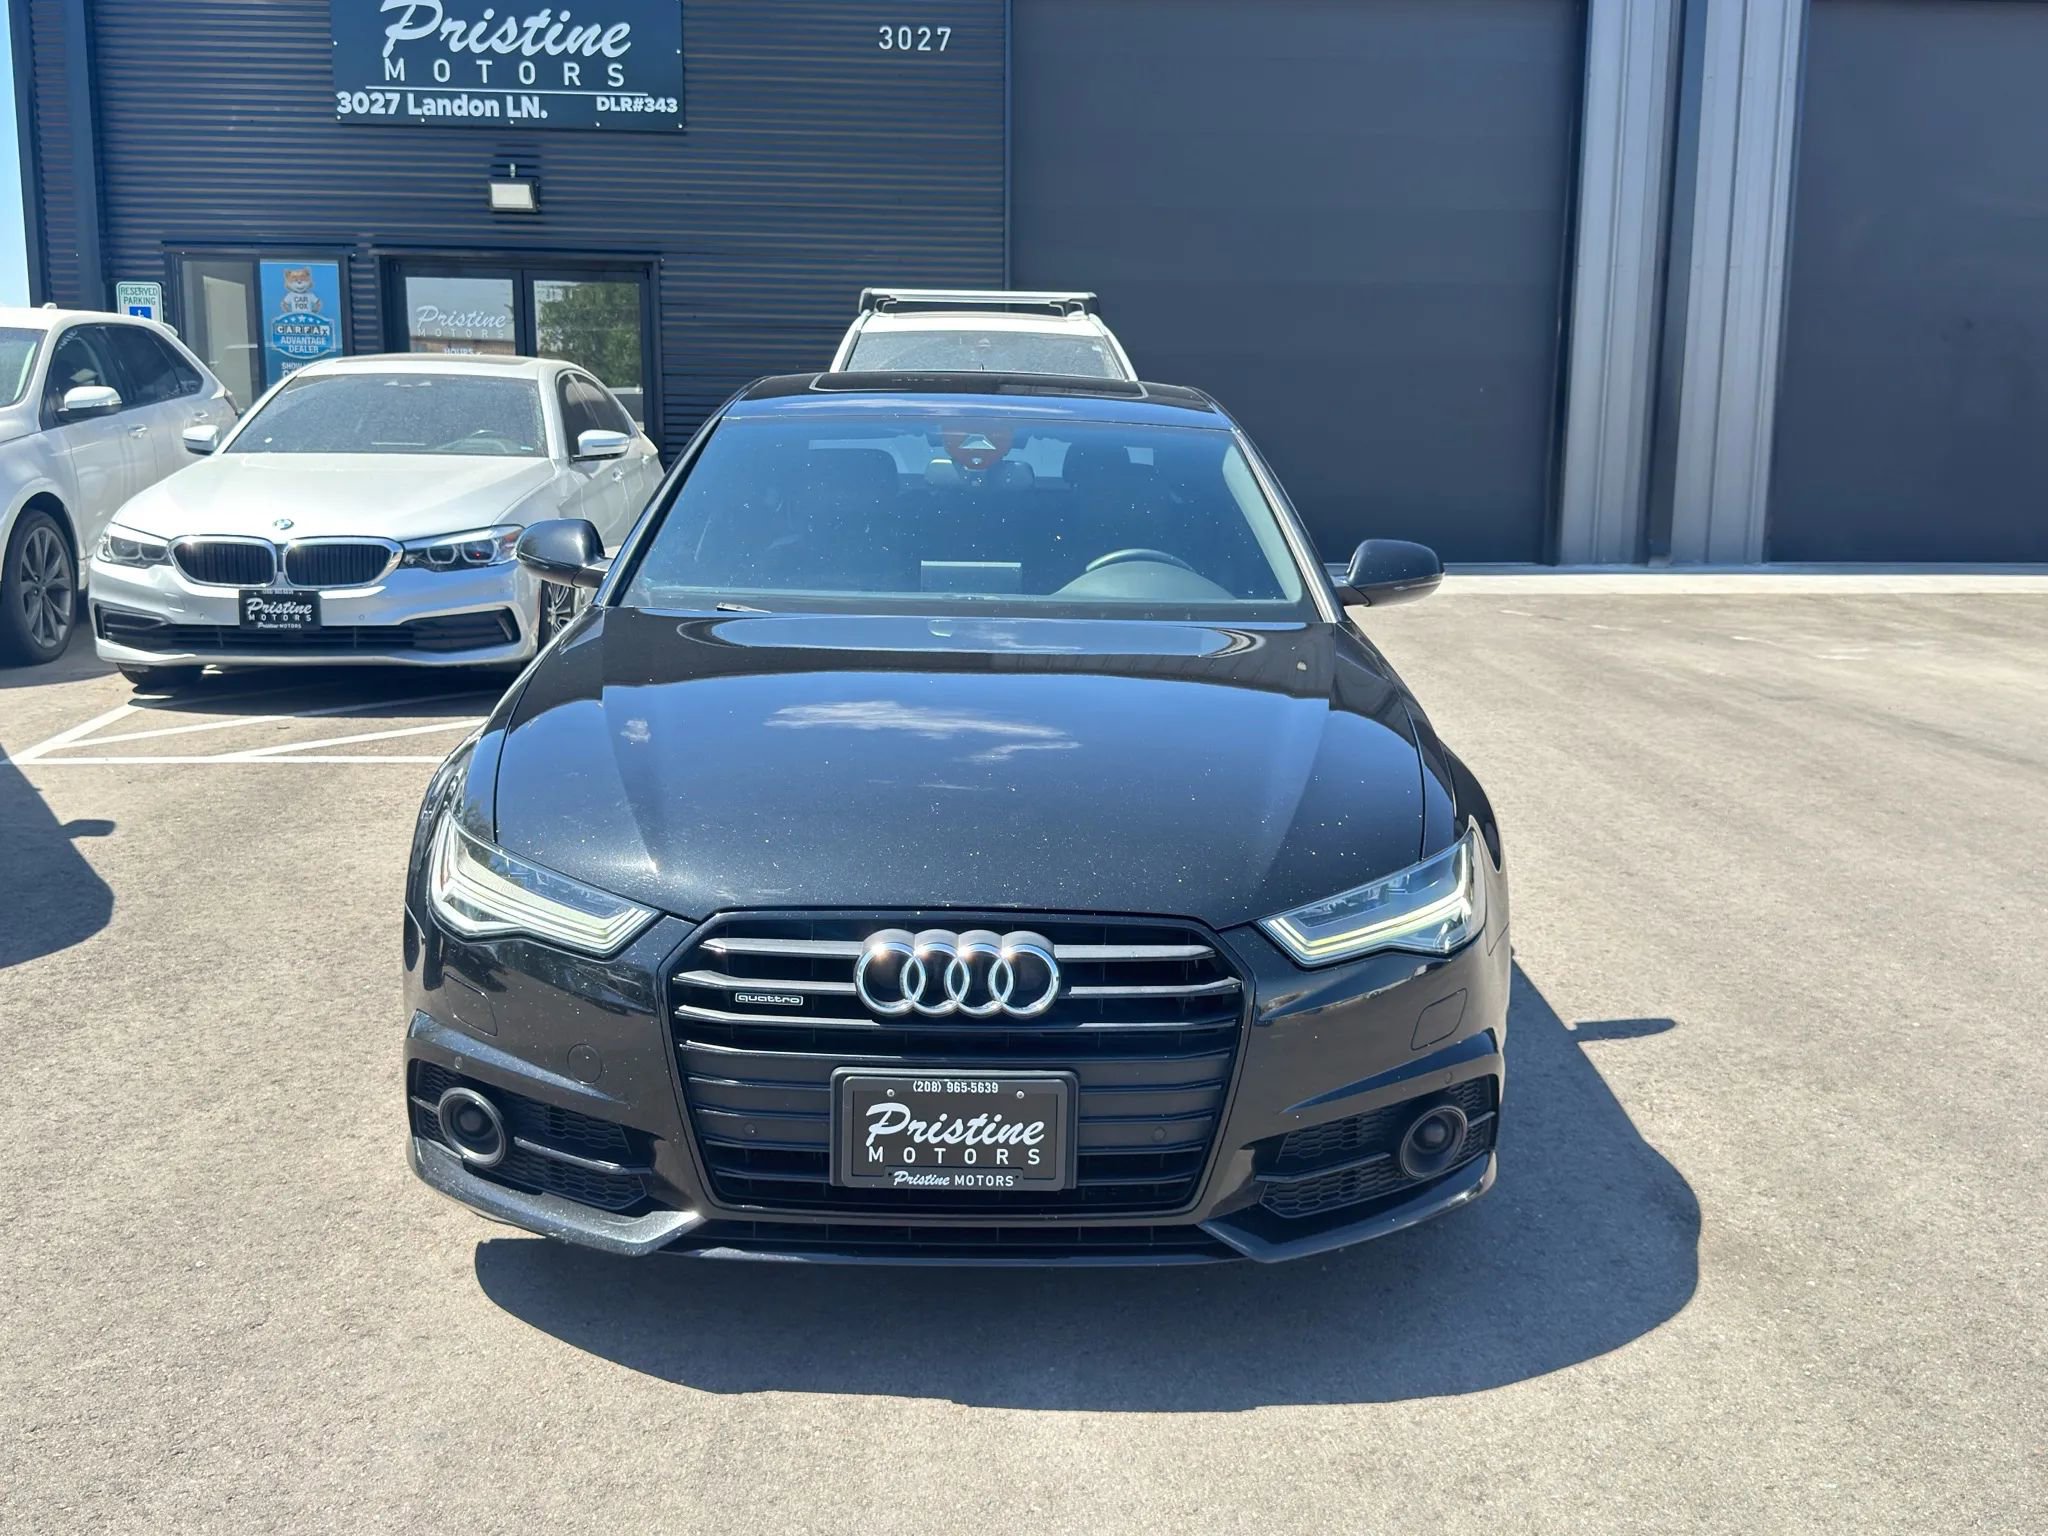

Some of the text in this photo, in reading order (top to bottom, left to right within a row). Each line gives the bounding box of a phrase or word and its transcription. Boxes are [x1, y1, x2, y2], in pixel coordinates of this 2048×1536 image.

[379, 0, 632, 58] Pristine
[878, 25, 952, 52] 3027
[384, 58, 625, 87] MOTORS
[336, 91, 548, 119] 3027 Landon LN.
[596, 96, 678, 114] DLR#343
[120, 286, 158, 296] RESERVED
[123, 296, 156, 306] PARKING
[416, 305, 506, 328] Pristine
[277, 325, 330, 335] CARFAX
[418, 328, 504, 338] MOTORS
[280, 335, 327, 345] ADVANTAGE
[288, 345, 319, 353] DEALER
[247, 598, 312, 615] Pristine
[249, 614, 312, 622] MOTORS
[738, 995, 800, 1004] quattro
[912, 1080, 999, 1093] (208) 965-5639
[865, 1102, 1045, 1147] Pristine
[867, 1146, 1040, 1165] MOTORS
[893, 1170, 1014, 1187] Pristine MOTORS
